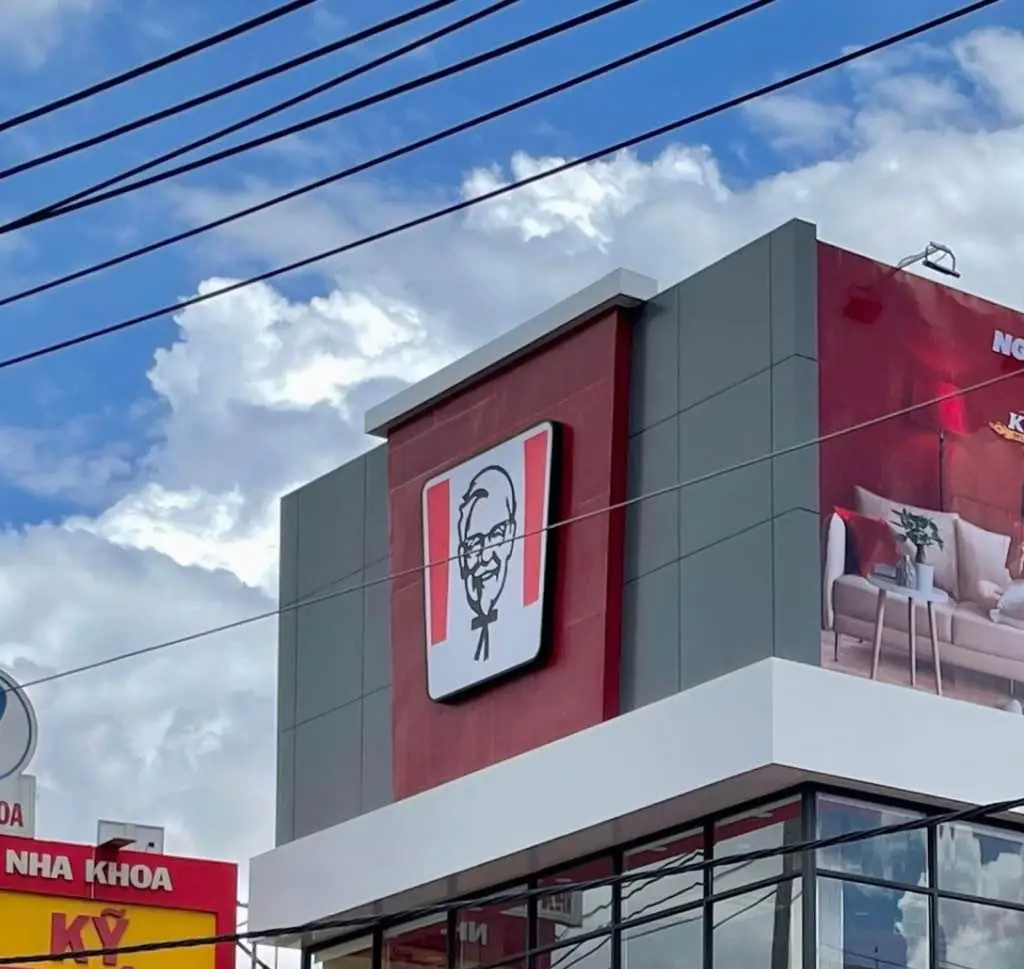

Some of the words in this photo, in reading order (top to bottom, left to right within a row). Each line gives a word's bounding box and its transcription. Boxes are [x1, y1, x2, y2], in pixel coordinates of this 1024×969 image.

[5, 848, 73, 880] NHA
[85, 858, 173, 892] KHOA
[50, 908, 130, 966] KỸ
